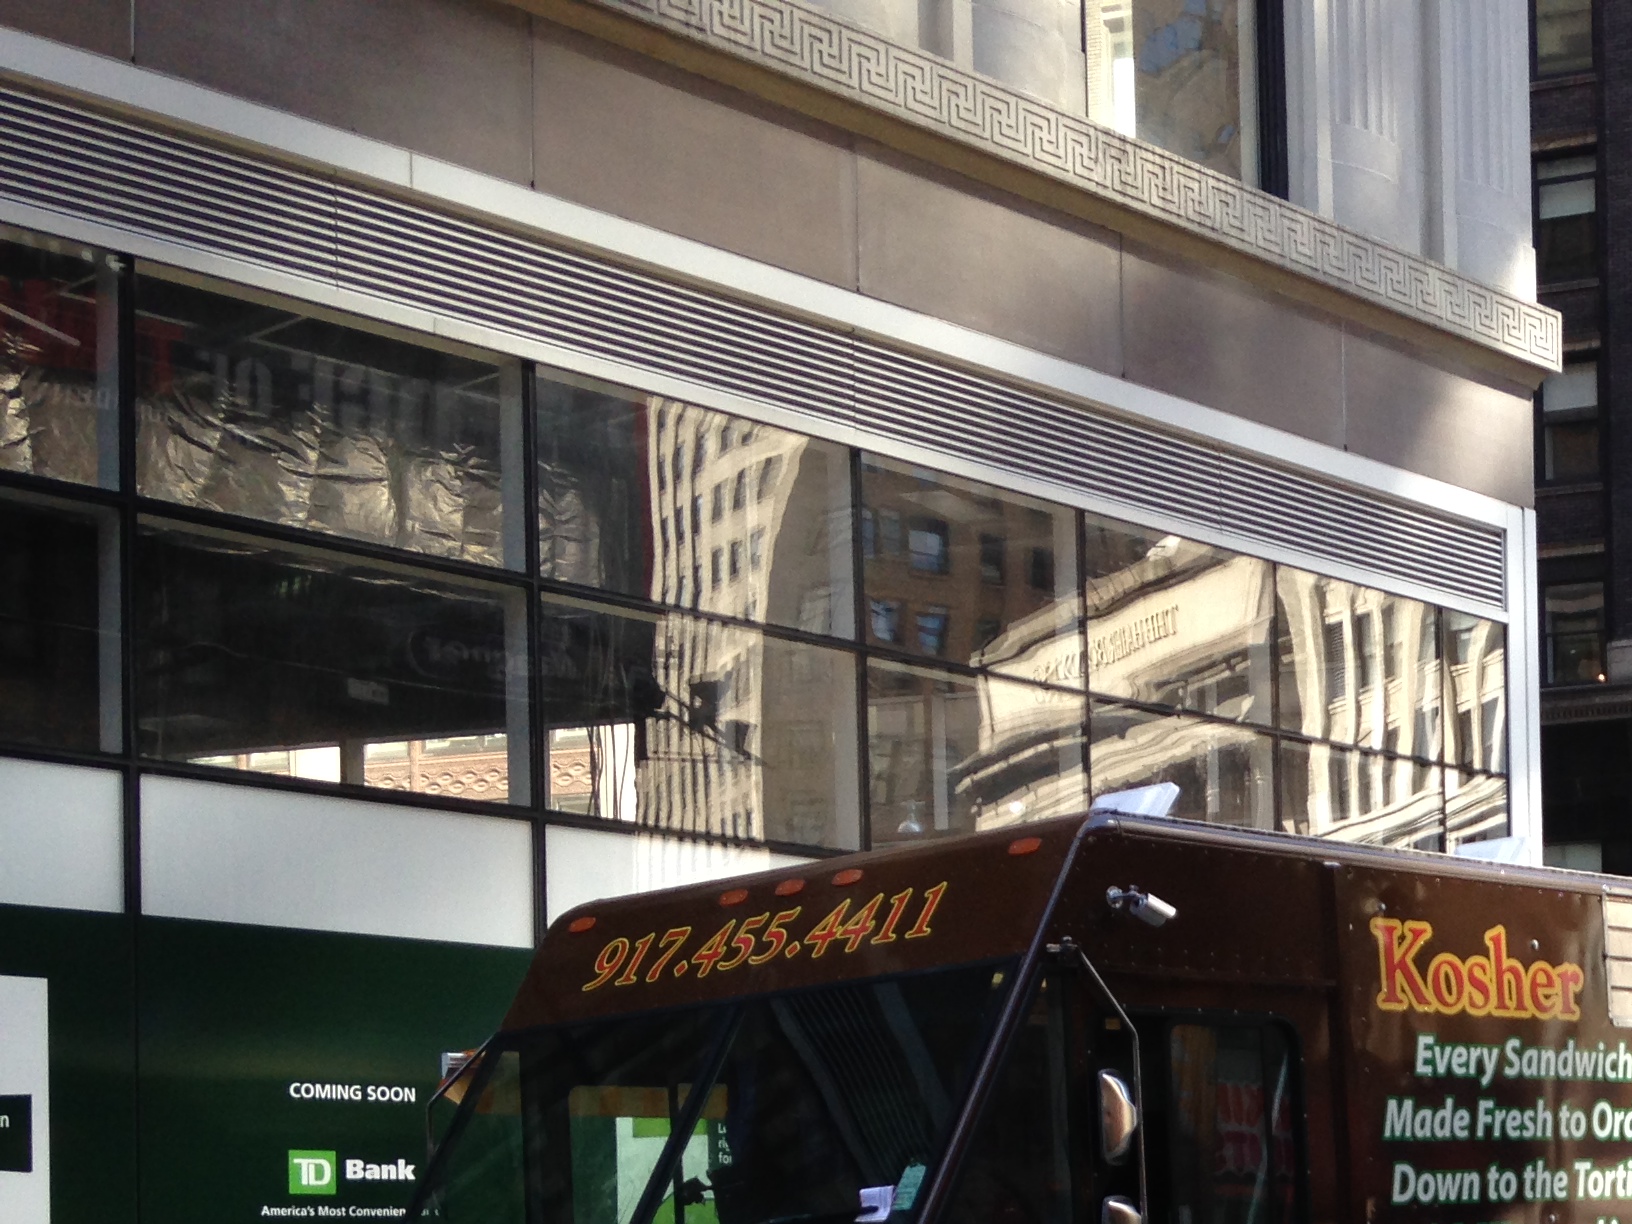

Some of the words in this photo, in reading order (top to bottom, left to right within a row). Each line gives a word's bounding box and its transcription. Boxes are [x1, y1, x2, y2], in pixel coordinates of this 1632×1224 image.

[582, 881, 948, 992] 917.455.4411
[1370, 918, 1584, 1021] Kosher
[1415, 1034, 1498, 1088] Every
[289, 1082, 362, 1100] COMING
[367, 1086, 416, 1102] SOON
[1383, 1095, 1470, 1140] Made
[1475, 1096, 1553, 1140] Fresh
[1559, 1105, 1585, 1140] to
[293, 1158, 331, 1186] TD
[345, 1159, 416, 1180] Bank
[1391, 1161, 1481, 1205] Down
[1486, 1165, 1518, 1202] to
[1523, 1160, 1568, 1200] the
[261, 1205, 315, 1217] America's
[318, 1206, 346, 1217] Most
[349, 1205, 406, 1217] Convenien
